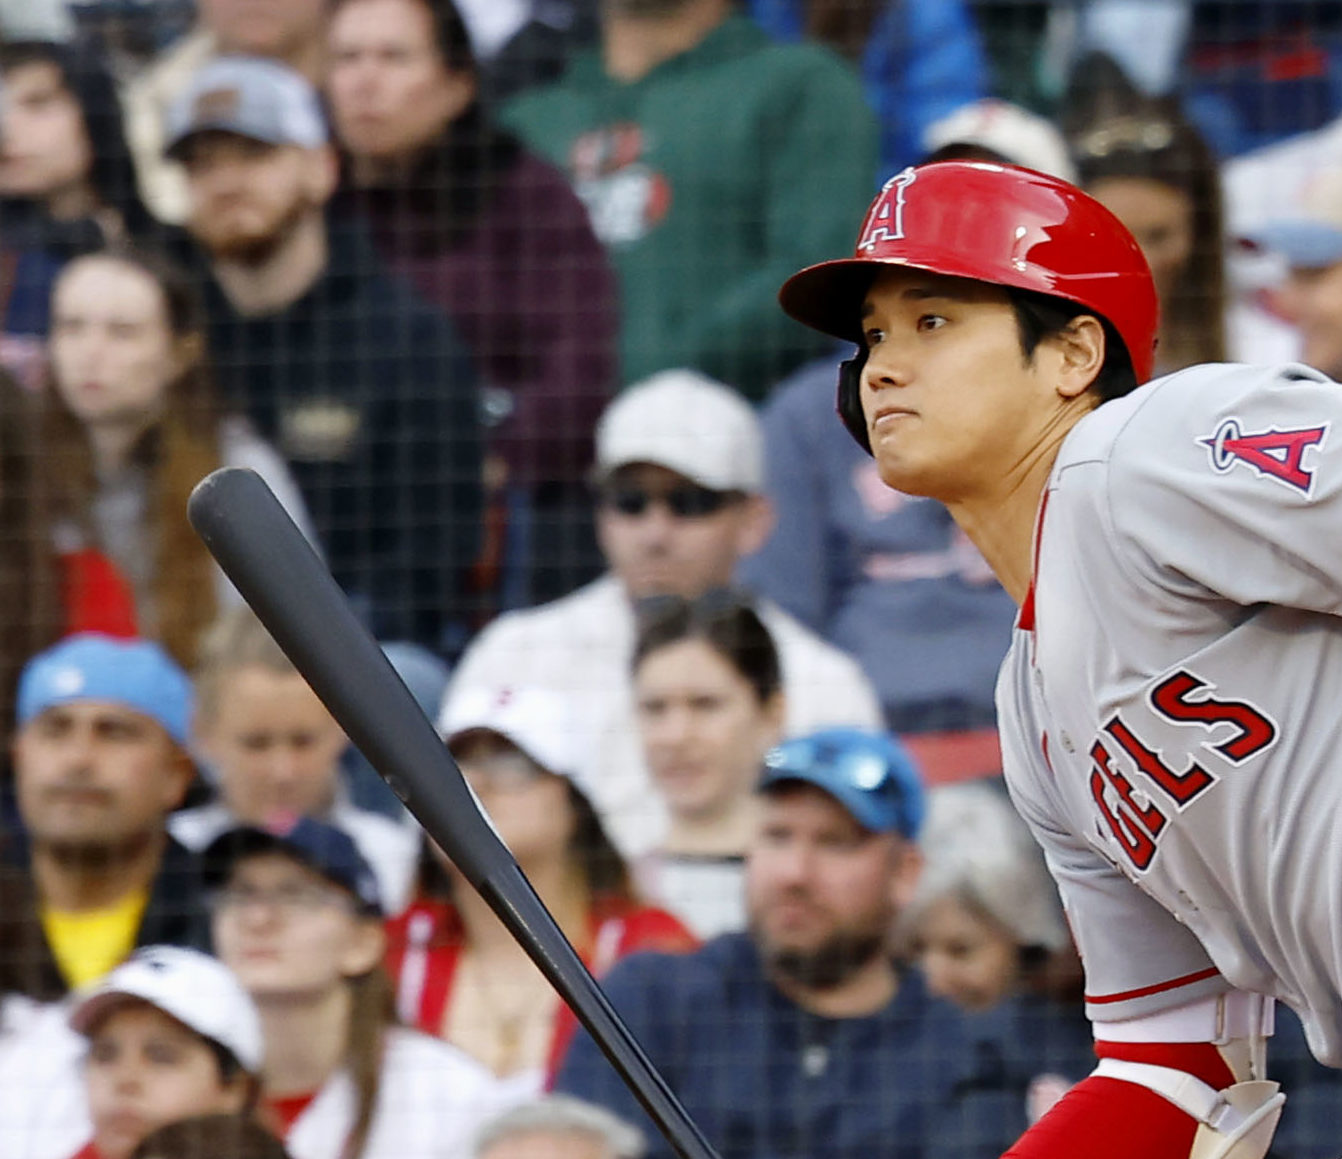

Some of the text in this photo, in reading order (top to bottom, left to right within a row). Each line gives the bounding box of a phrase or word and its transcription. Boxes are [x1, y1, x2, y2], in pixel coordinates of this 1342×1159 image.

[857, 167, 917, 250] A
[1195, 417, 1331, 501] A
[1086, 667, 1281, 874] GELS
